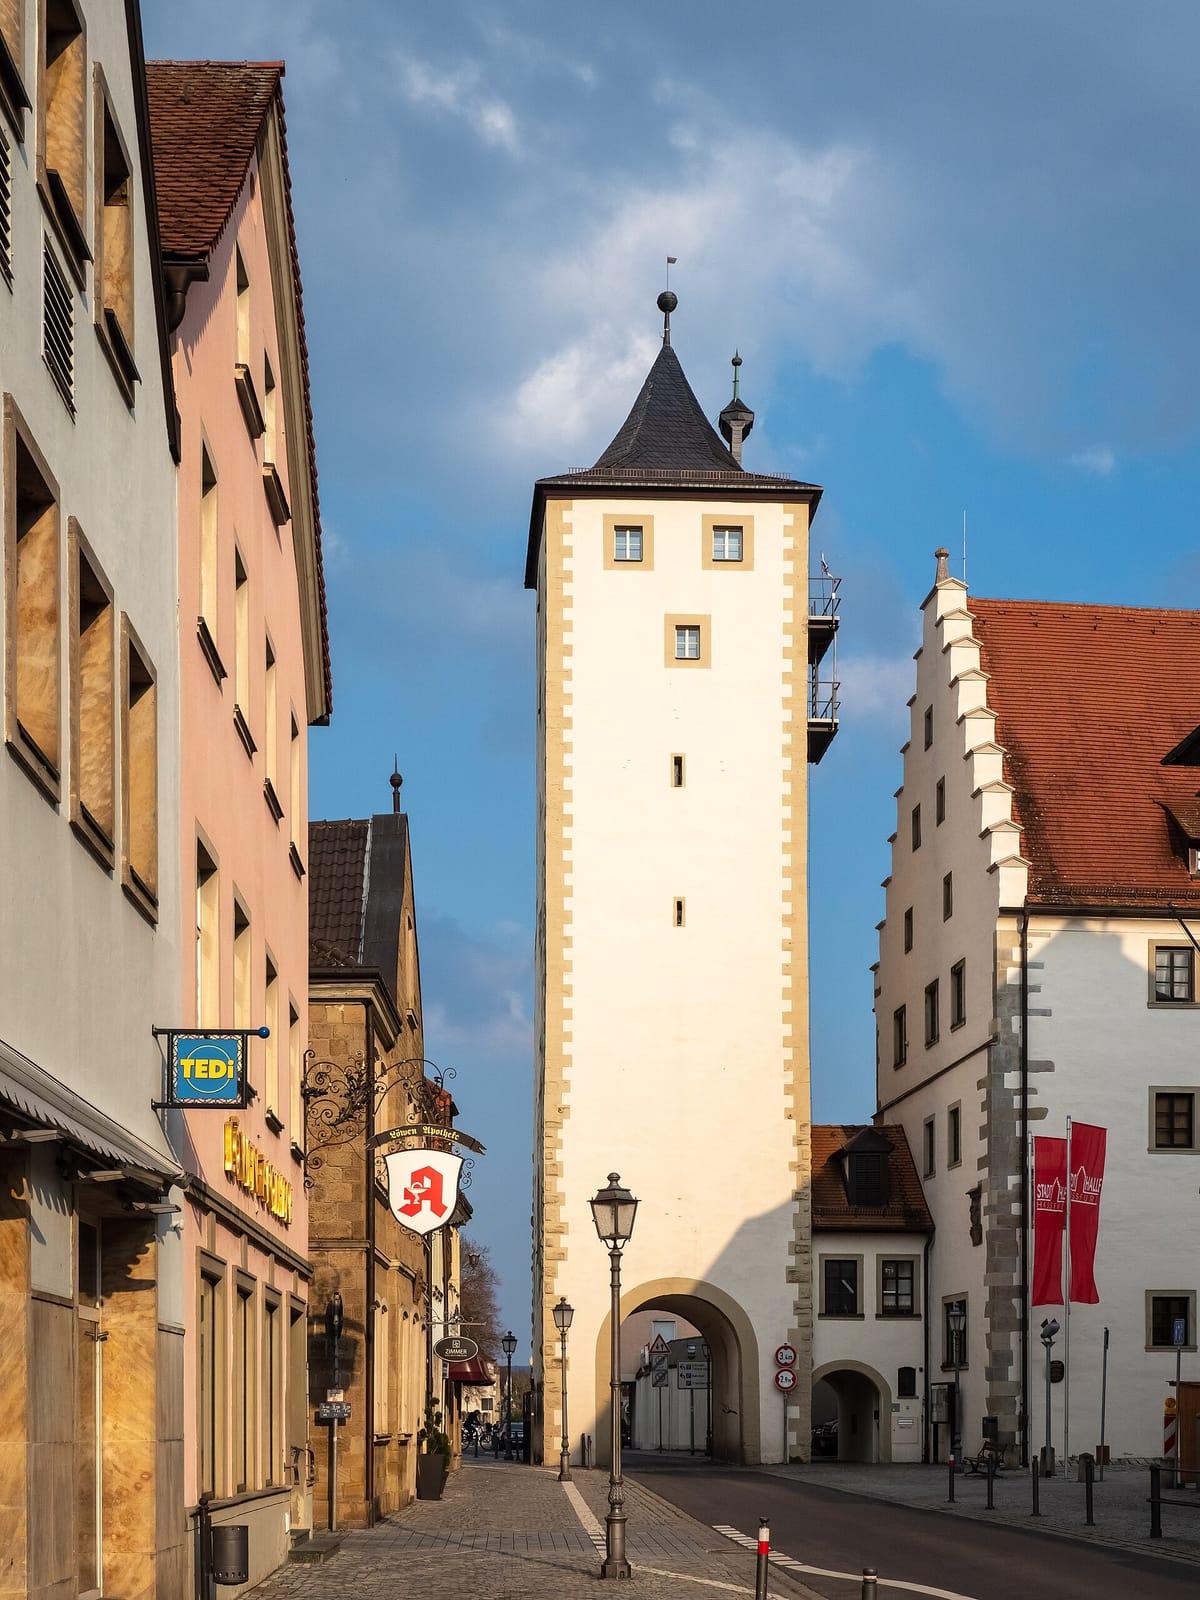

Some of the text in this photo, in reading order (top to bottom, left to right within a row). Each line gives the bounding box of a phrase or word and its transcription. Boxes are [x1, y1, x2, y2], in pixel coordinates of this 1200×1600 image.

[180, 1059, 234, 1079] TEDi
[389, 1125, 460, 1141] Löwen Apotheke
